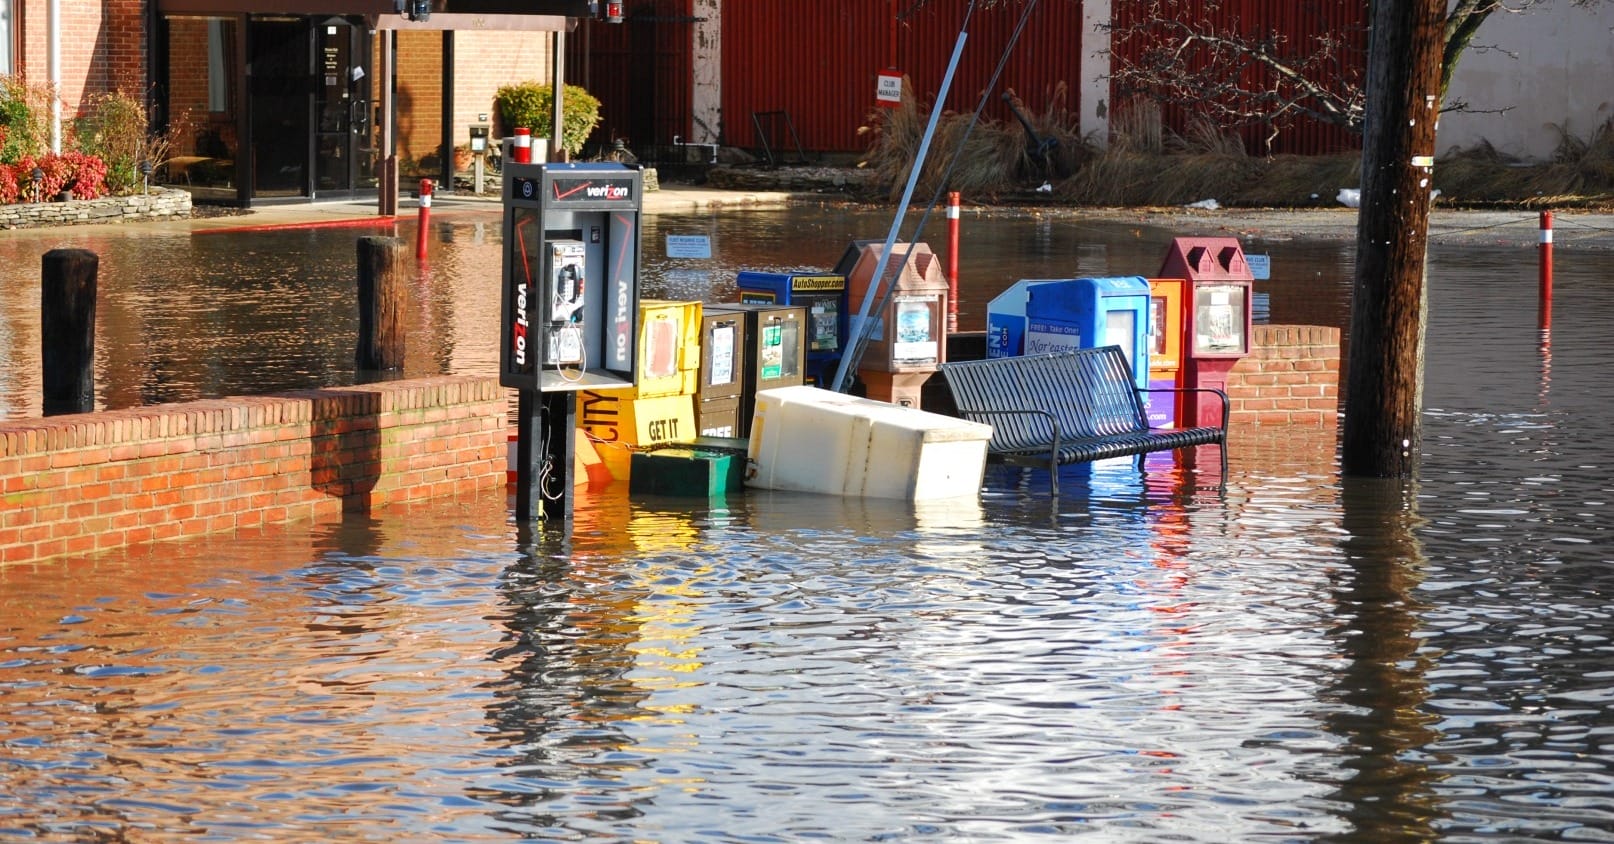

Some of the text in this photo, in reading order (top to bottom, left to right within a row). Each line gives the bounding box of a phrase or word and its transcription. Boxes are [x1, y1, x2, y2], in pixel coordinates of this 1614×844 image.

[587, 183, 629, 200] verizon
[793, 279, 845, 291] AutoShopper.com
[513, 283, 529, 365] verizon
[583, 389, 619, 444] CITY
[648, 417, 679, 441] GET IT
